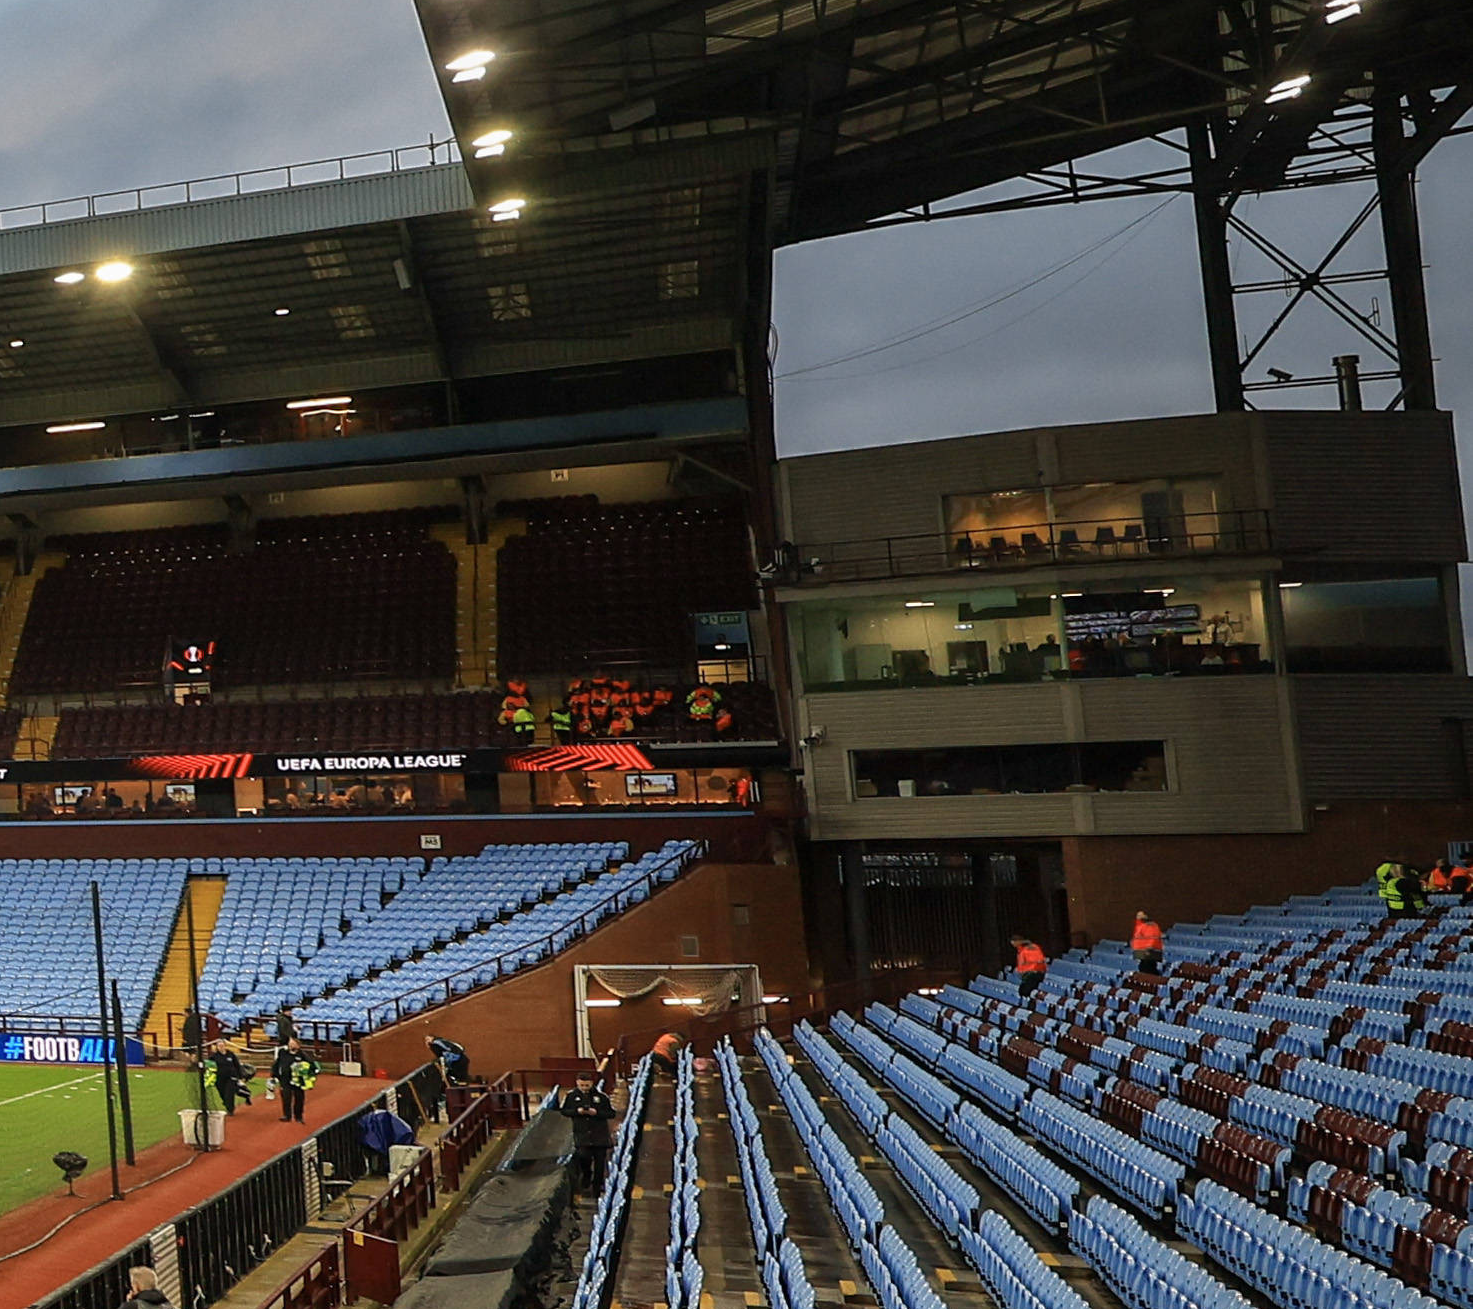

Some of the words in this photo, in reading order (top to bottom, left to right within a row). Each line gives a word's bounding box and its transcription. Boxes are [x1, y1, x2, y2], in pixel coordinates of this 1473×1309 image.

[277, 758, 322, 771] UEFA
[325, 757, 391, 770] EUROPA
[394, 755, 462, 768] LEAGUE
